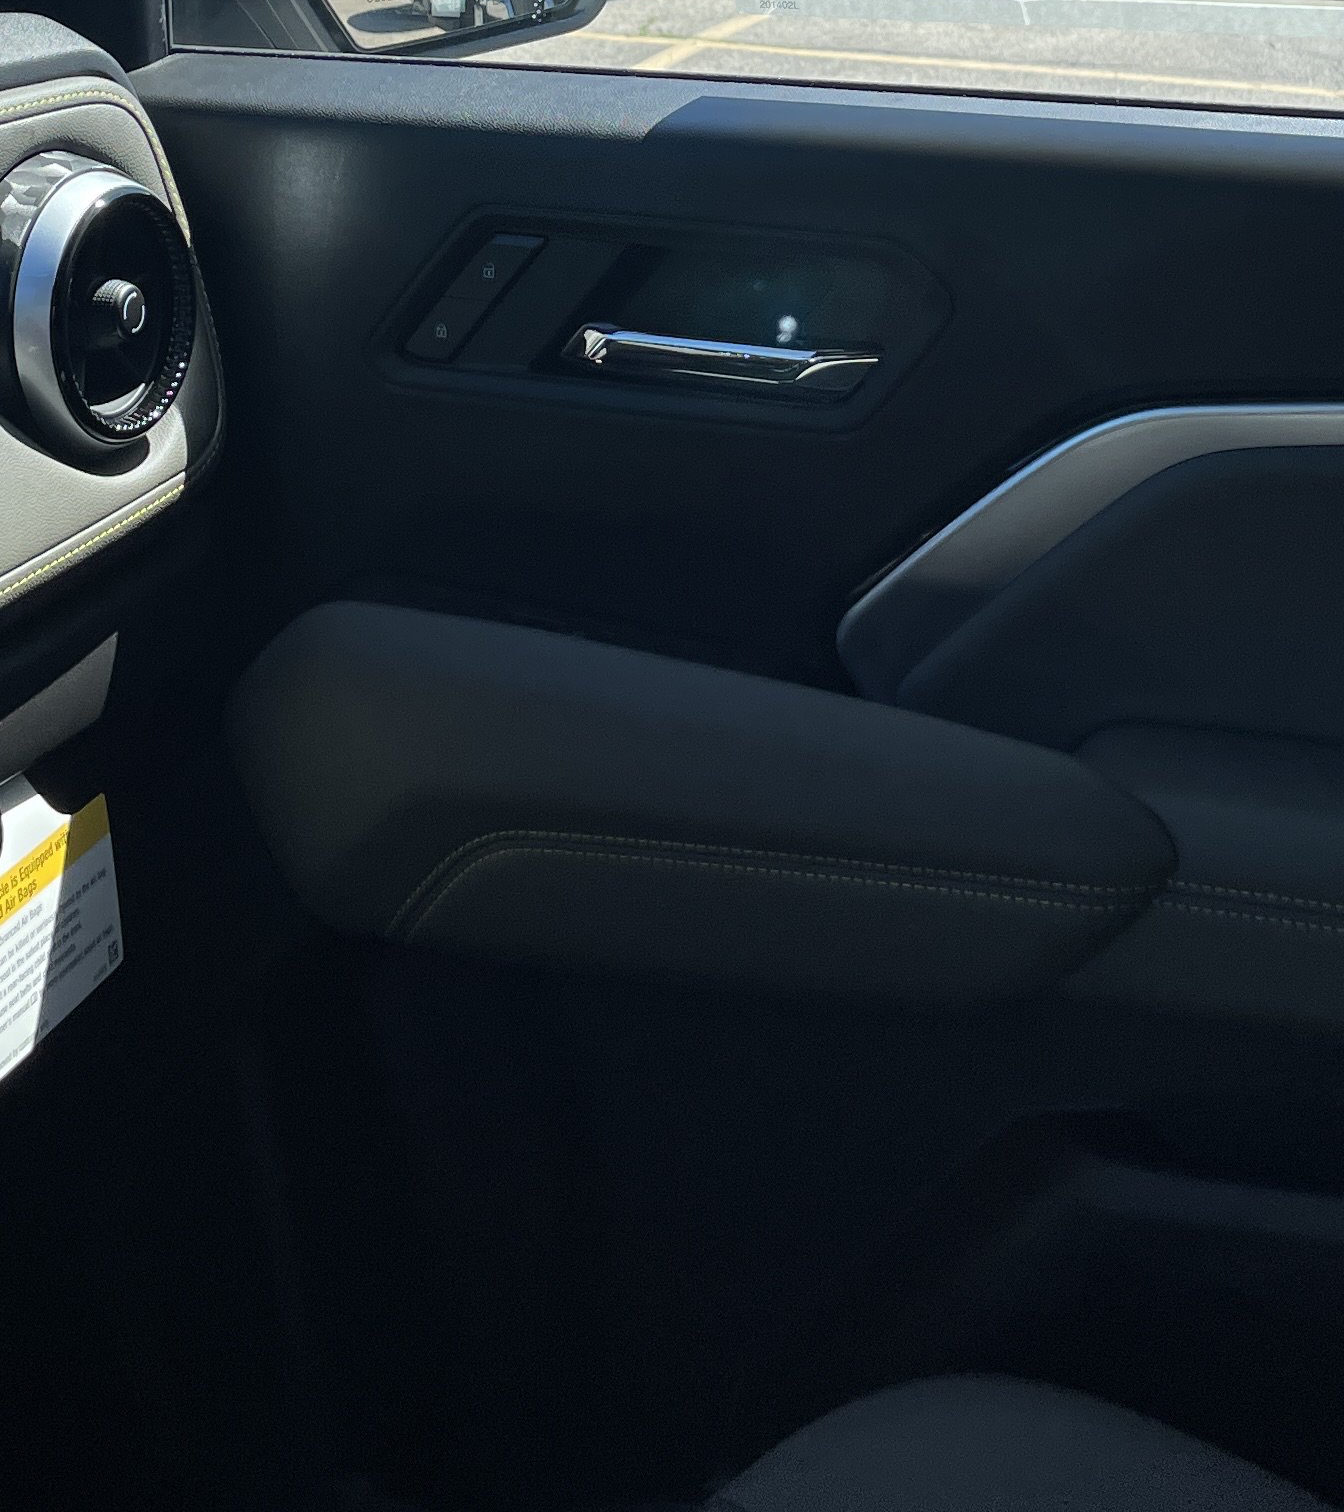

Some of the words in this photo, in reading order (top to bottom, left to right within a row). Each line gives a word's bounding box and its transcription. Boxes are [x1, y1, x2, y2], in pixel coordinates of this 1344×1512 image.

[11, 874, 18, 888] is
[19, 844, 53, 881] Equipped
[55, 830, 69, 852] wit
[5, 897, 16, 913] Air
[18, 879, 37, 902] Bags
